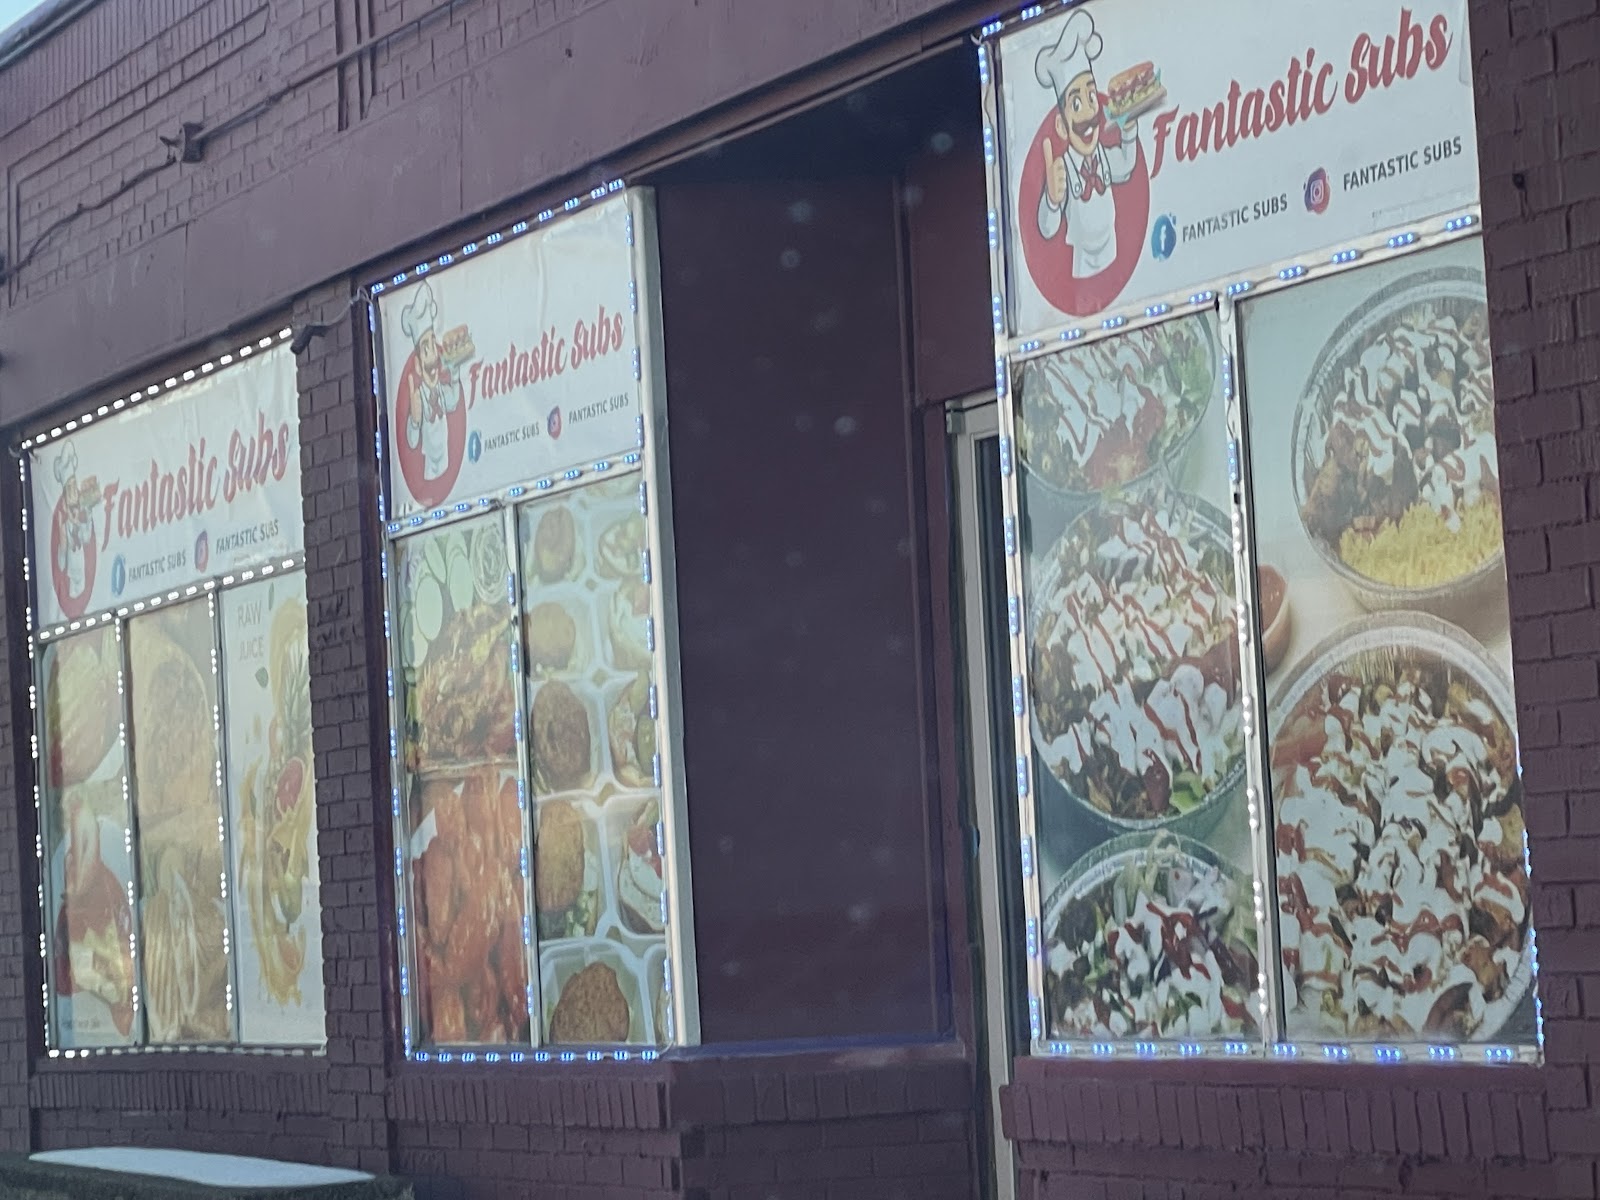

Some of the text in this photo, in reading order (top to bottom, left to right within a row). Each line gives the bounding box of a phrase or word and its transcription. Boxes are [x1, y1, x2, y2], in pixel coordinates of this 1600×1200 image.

[1150, 48, 1338, 179] Fantastic
[1342, 136, 1462, 192] FANTASTIC SUBS
[1182, 194, 1288, 244] FANTASTIC SUBS
[468, 325, 568, 410] Fantastic
[569, 392, 629, 424] FANTASTIC SUBS
[484, 422, 540, 452] FANTASTIC SUBS
[102, 437, 219, 552] Fantastic
[216, 518, 279, 554] FANTASTIC SUBS
[128, 550, 186, 582] FANTASTIC SUBS
[237, 600, 261, 627] RAW
